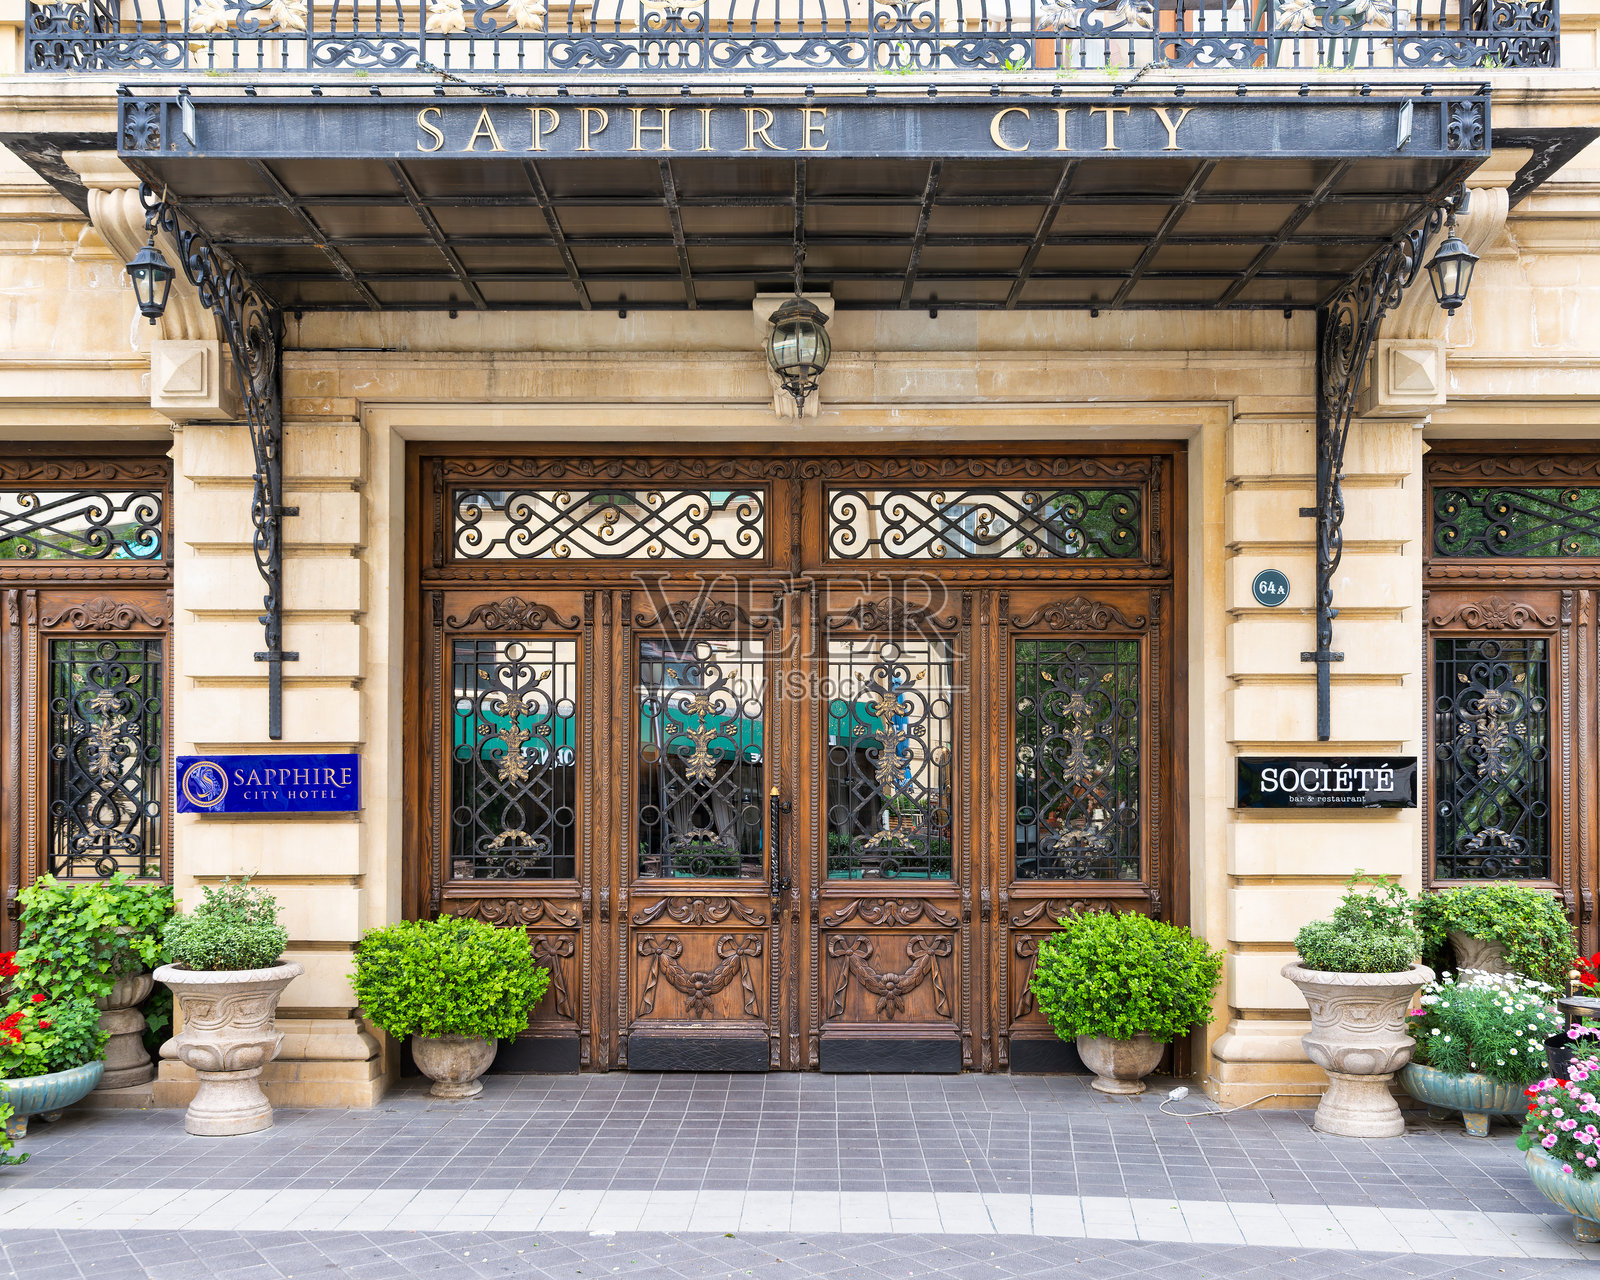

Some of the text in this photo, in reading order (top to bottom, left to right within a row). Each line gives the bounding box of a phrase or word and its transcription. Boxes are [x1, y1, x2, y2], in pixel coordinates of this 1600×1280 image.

[416, 106, 1196, 153] SAPPHIRE CITY
[233, 767, 353, 789] SAPPHIRE
[1260, 763, 1395, 793] SOCIÉTÉ
[243, 789, 338, 801] CITY HOTEL
[1289, 795, 1367, 803] bar & restaurant
